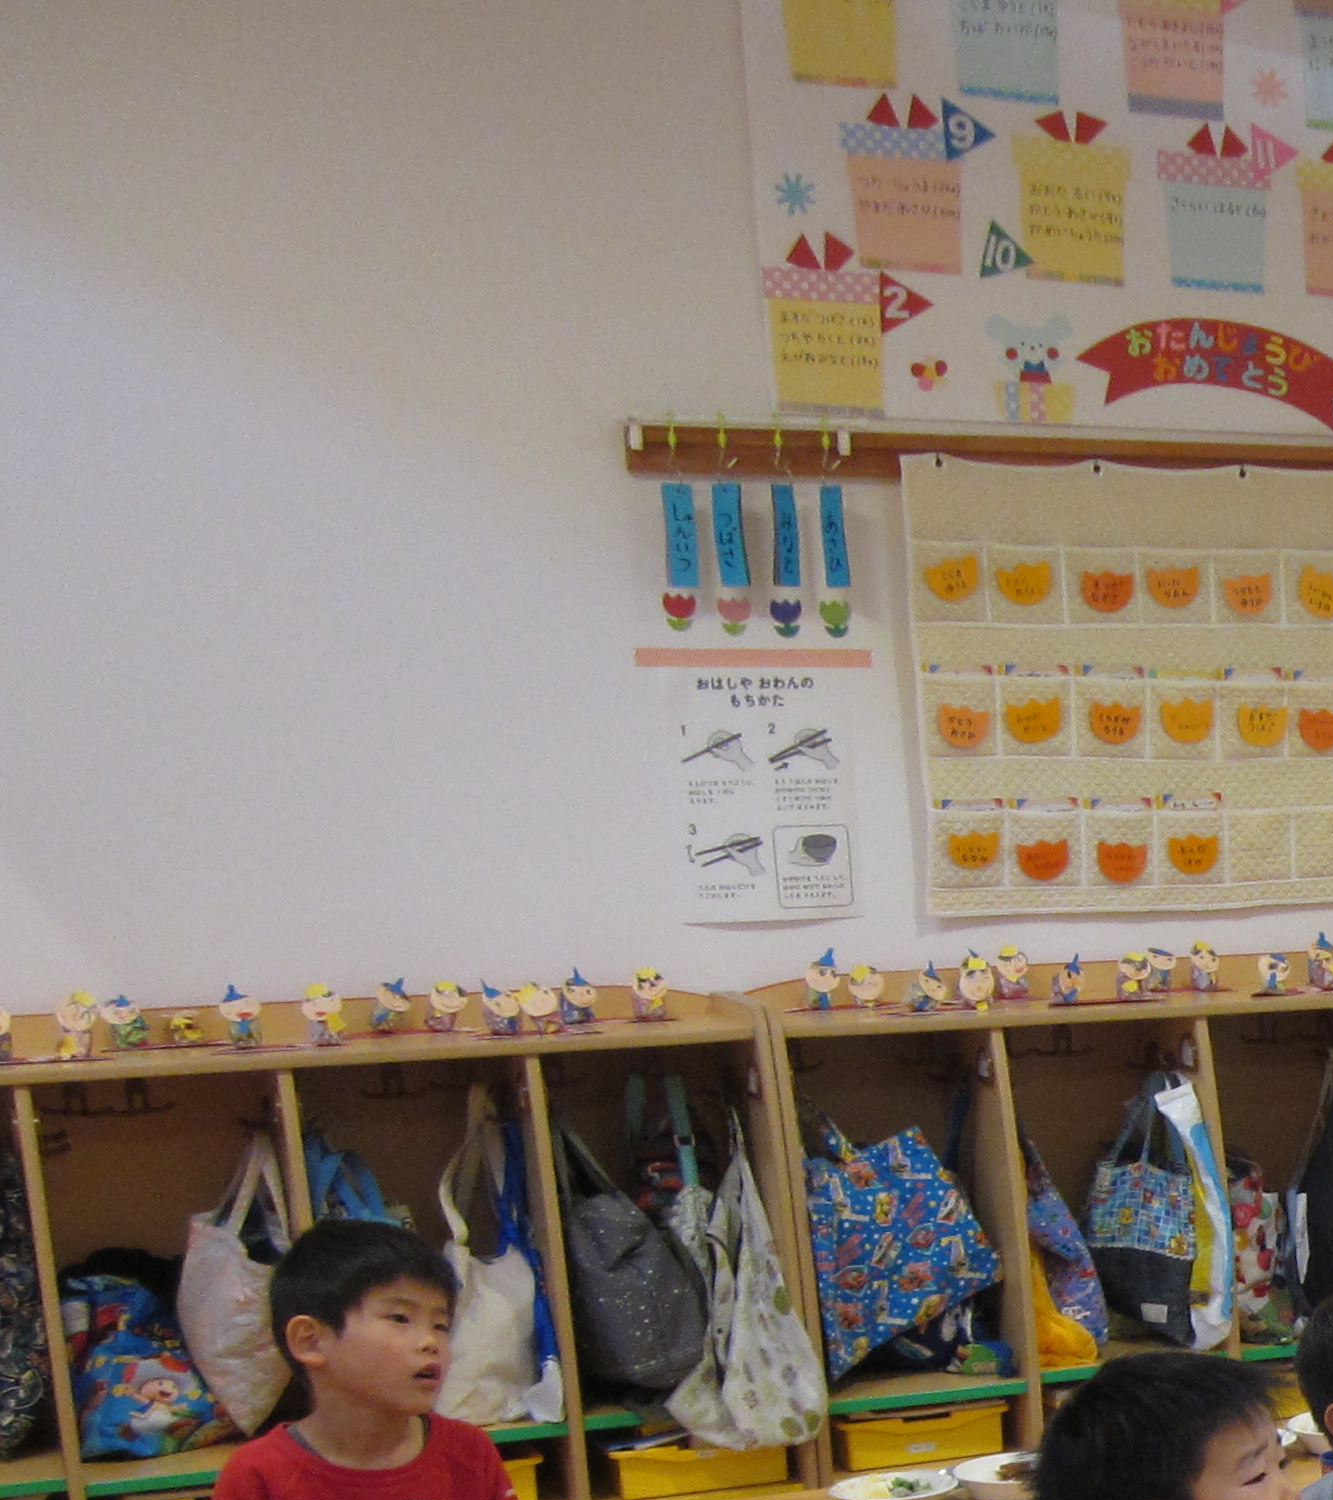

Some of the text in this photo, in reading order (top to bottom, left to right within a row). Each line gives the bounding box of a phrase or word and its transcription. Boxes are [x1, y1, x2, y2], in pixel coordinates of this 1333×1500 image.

[949, 114, 976, 150] 9
[1257, 139, 1277, 170] 11
[985, 236, 1016, 272] 10
[884, 287, 910, 319] 2
[1125, 321, 1324, 373] おたんじょうび
[696, 676, 815, 691] おはしや おわんの
[730, 694, 785, 708] もちかた
[681, 725, 686, 737] 1
[768, 723, 776, 735] 2
[688, 824, 697, 836] 3
